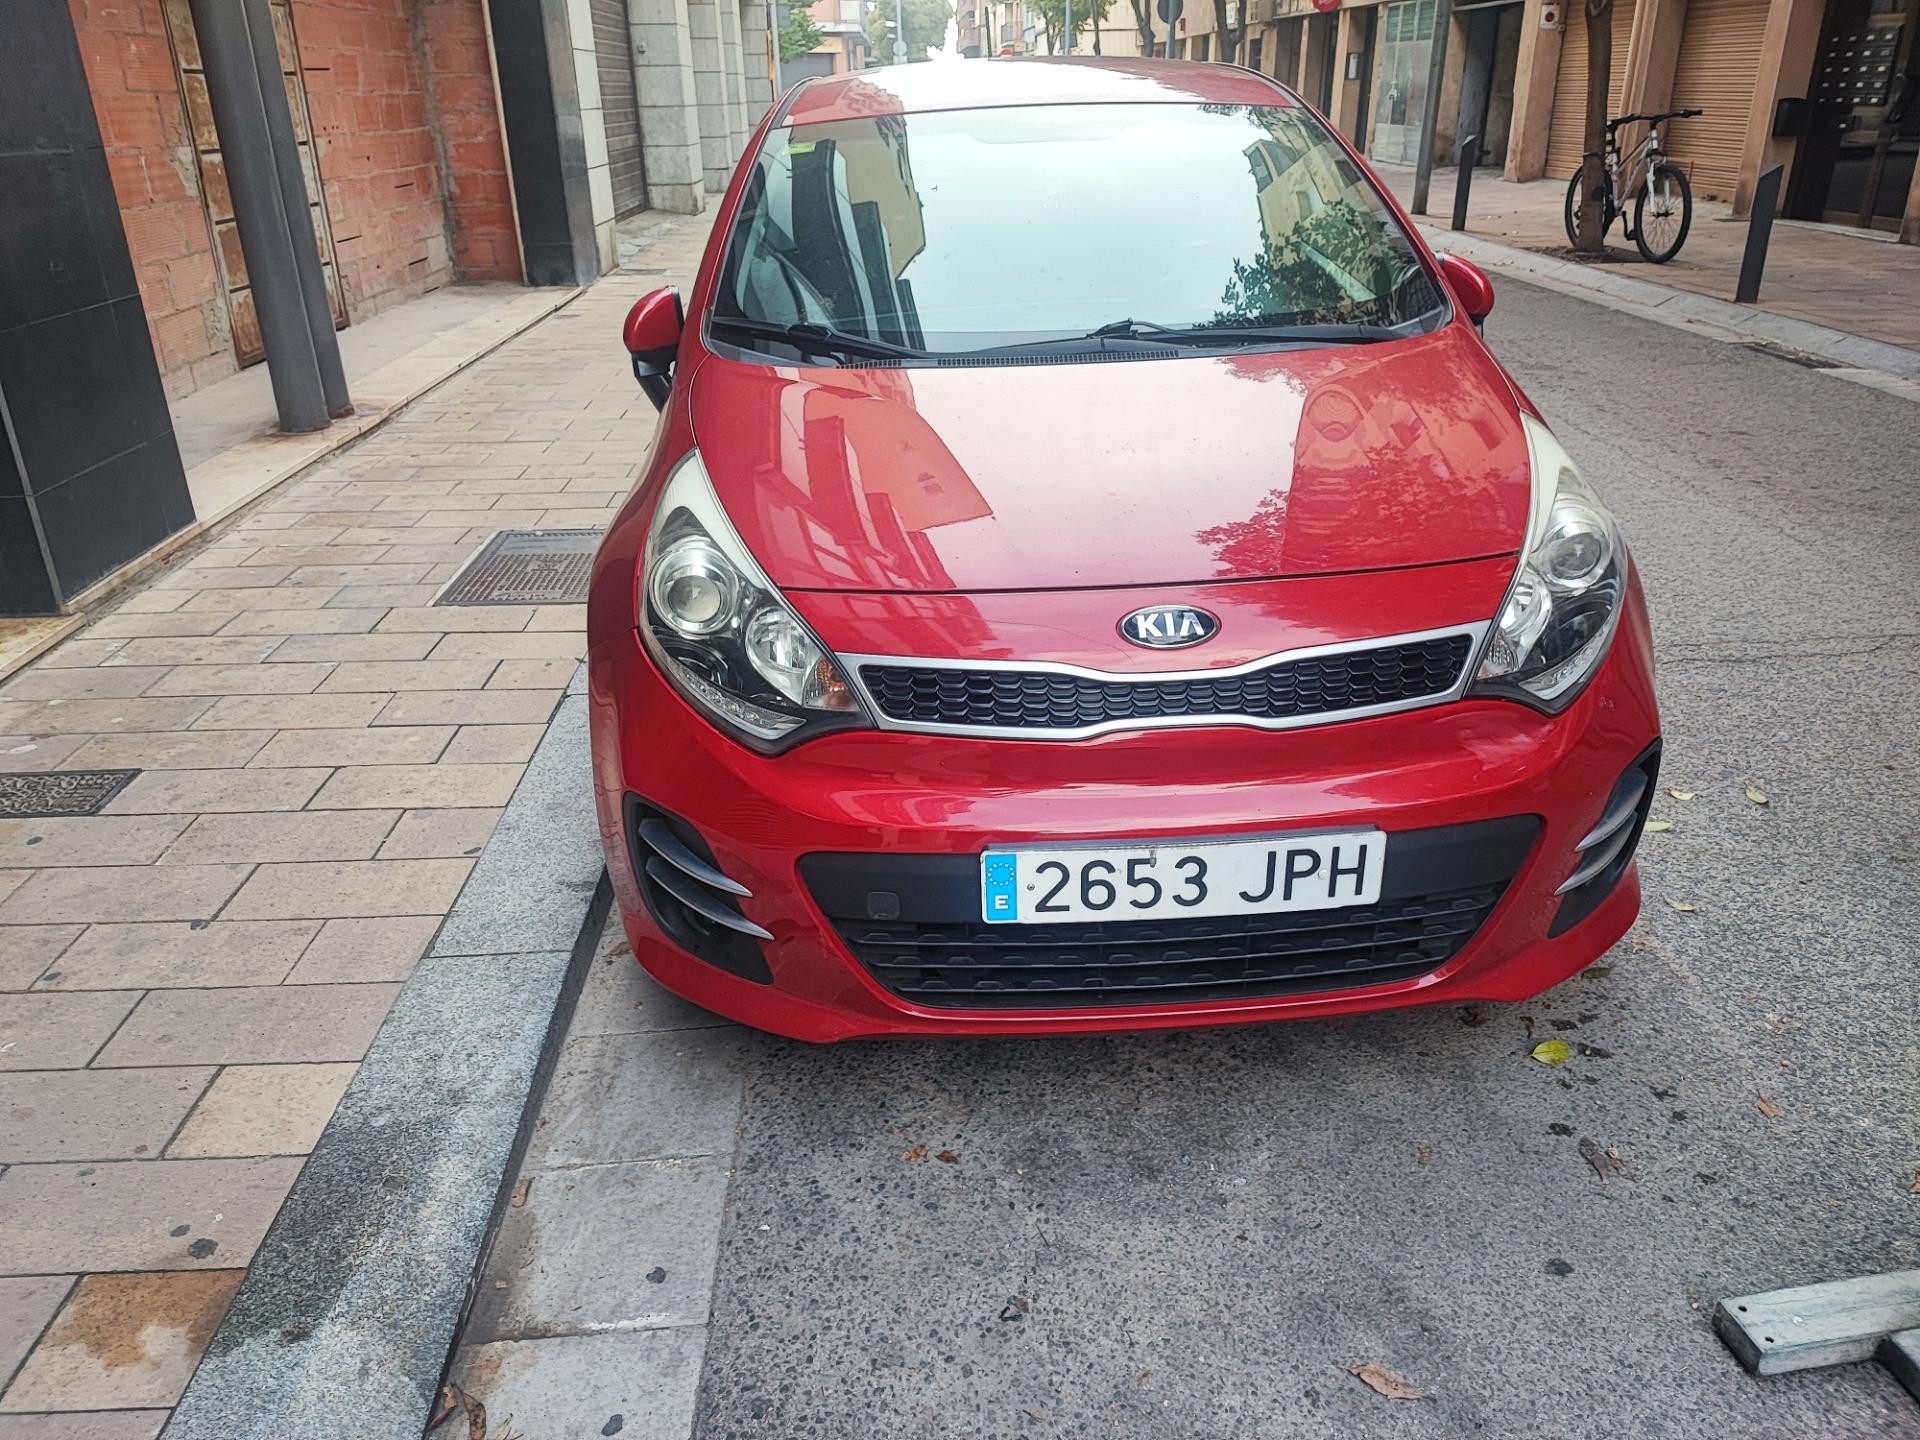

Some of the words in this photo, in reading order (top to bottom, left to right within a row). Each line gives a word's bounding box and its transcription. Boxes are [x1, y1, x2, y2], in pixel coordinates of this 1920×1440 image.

[1135, 611, 1205, 638] KIA
[1034, 855, 1208, 913] 2653
[1238, 844, 1368, 903] JPH
[995, 895, 1009, 910] E
